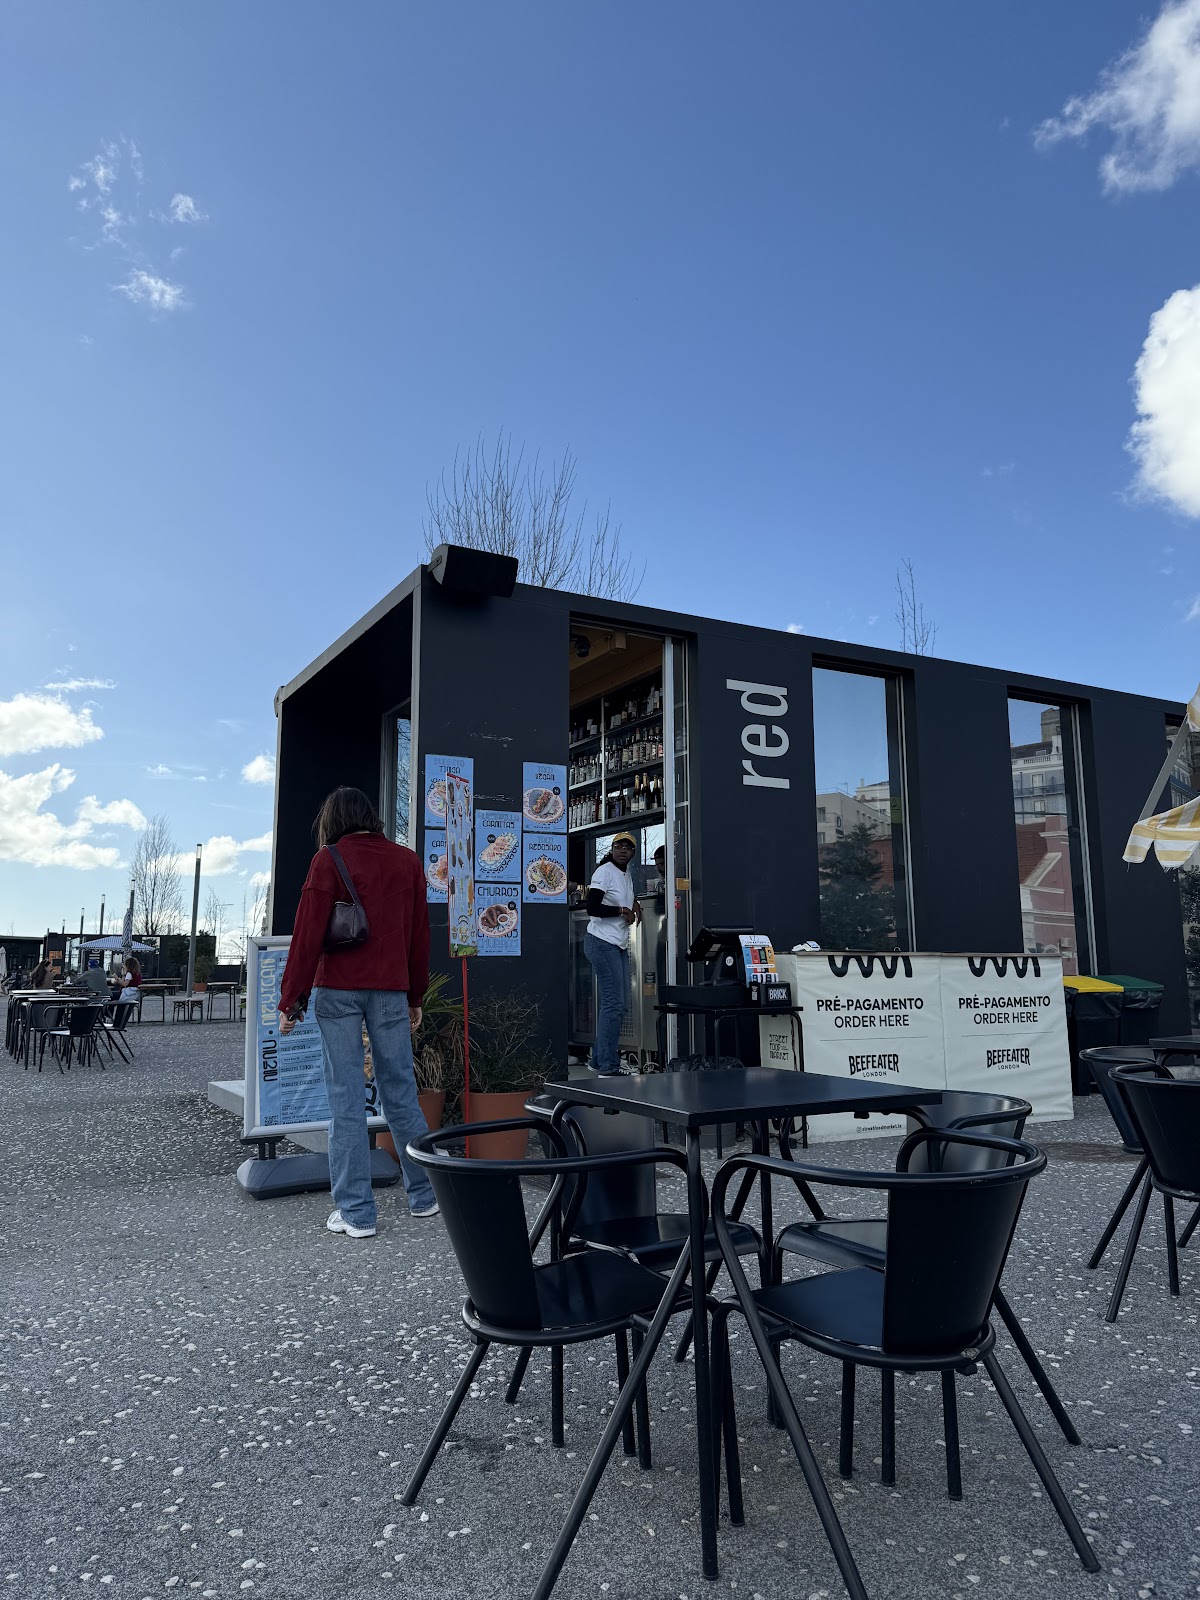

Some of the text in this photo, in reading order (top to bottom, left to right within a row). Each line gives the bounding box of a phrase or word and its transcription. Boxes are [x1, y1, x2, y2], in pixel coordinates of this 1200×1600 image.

[726, 678, 790, 789] red
[482, 819, 515, 828] CARNITAS
[477, 886, 519, 897] CHURROS
[769, 988, 788, 1000] BRICK
[958, 993, 1051, 1009] PRÉ-PAGAMENTO
[816, 995, 924, 1012] PRÉ-PAGAMENTO
[260, 958, 278, 1082] MENU MEXICAN
[834, 1014, 910, 1028] ORDER HERE
[973, 1011, 1039, 1025] ORDER HERE
[848, 1053, 899, 1076] BEEFEATER
[986, 1047, 1031, 1069] BEEFEATER
[862, 1070, 887, 1078] LONDON
